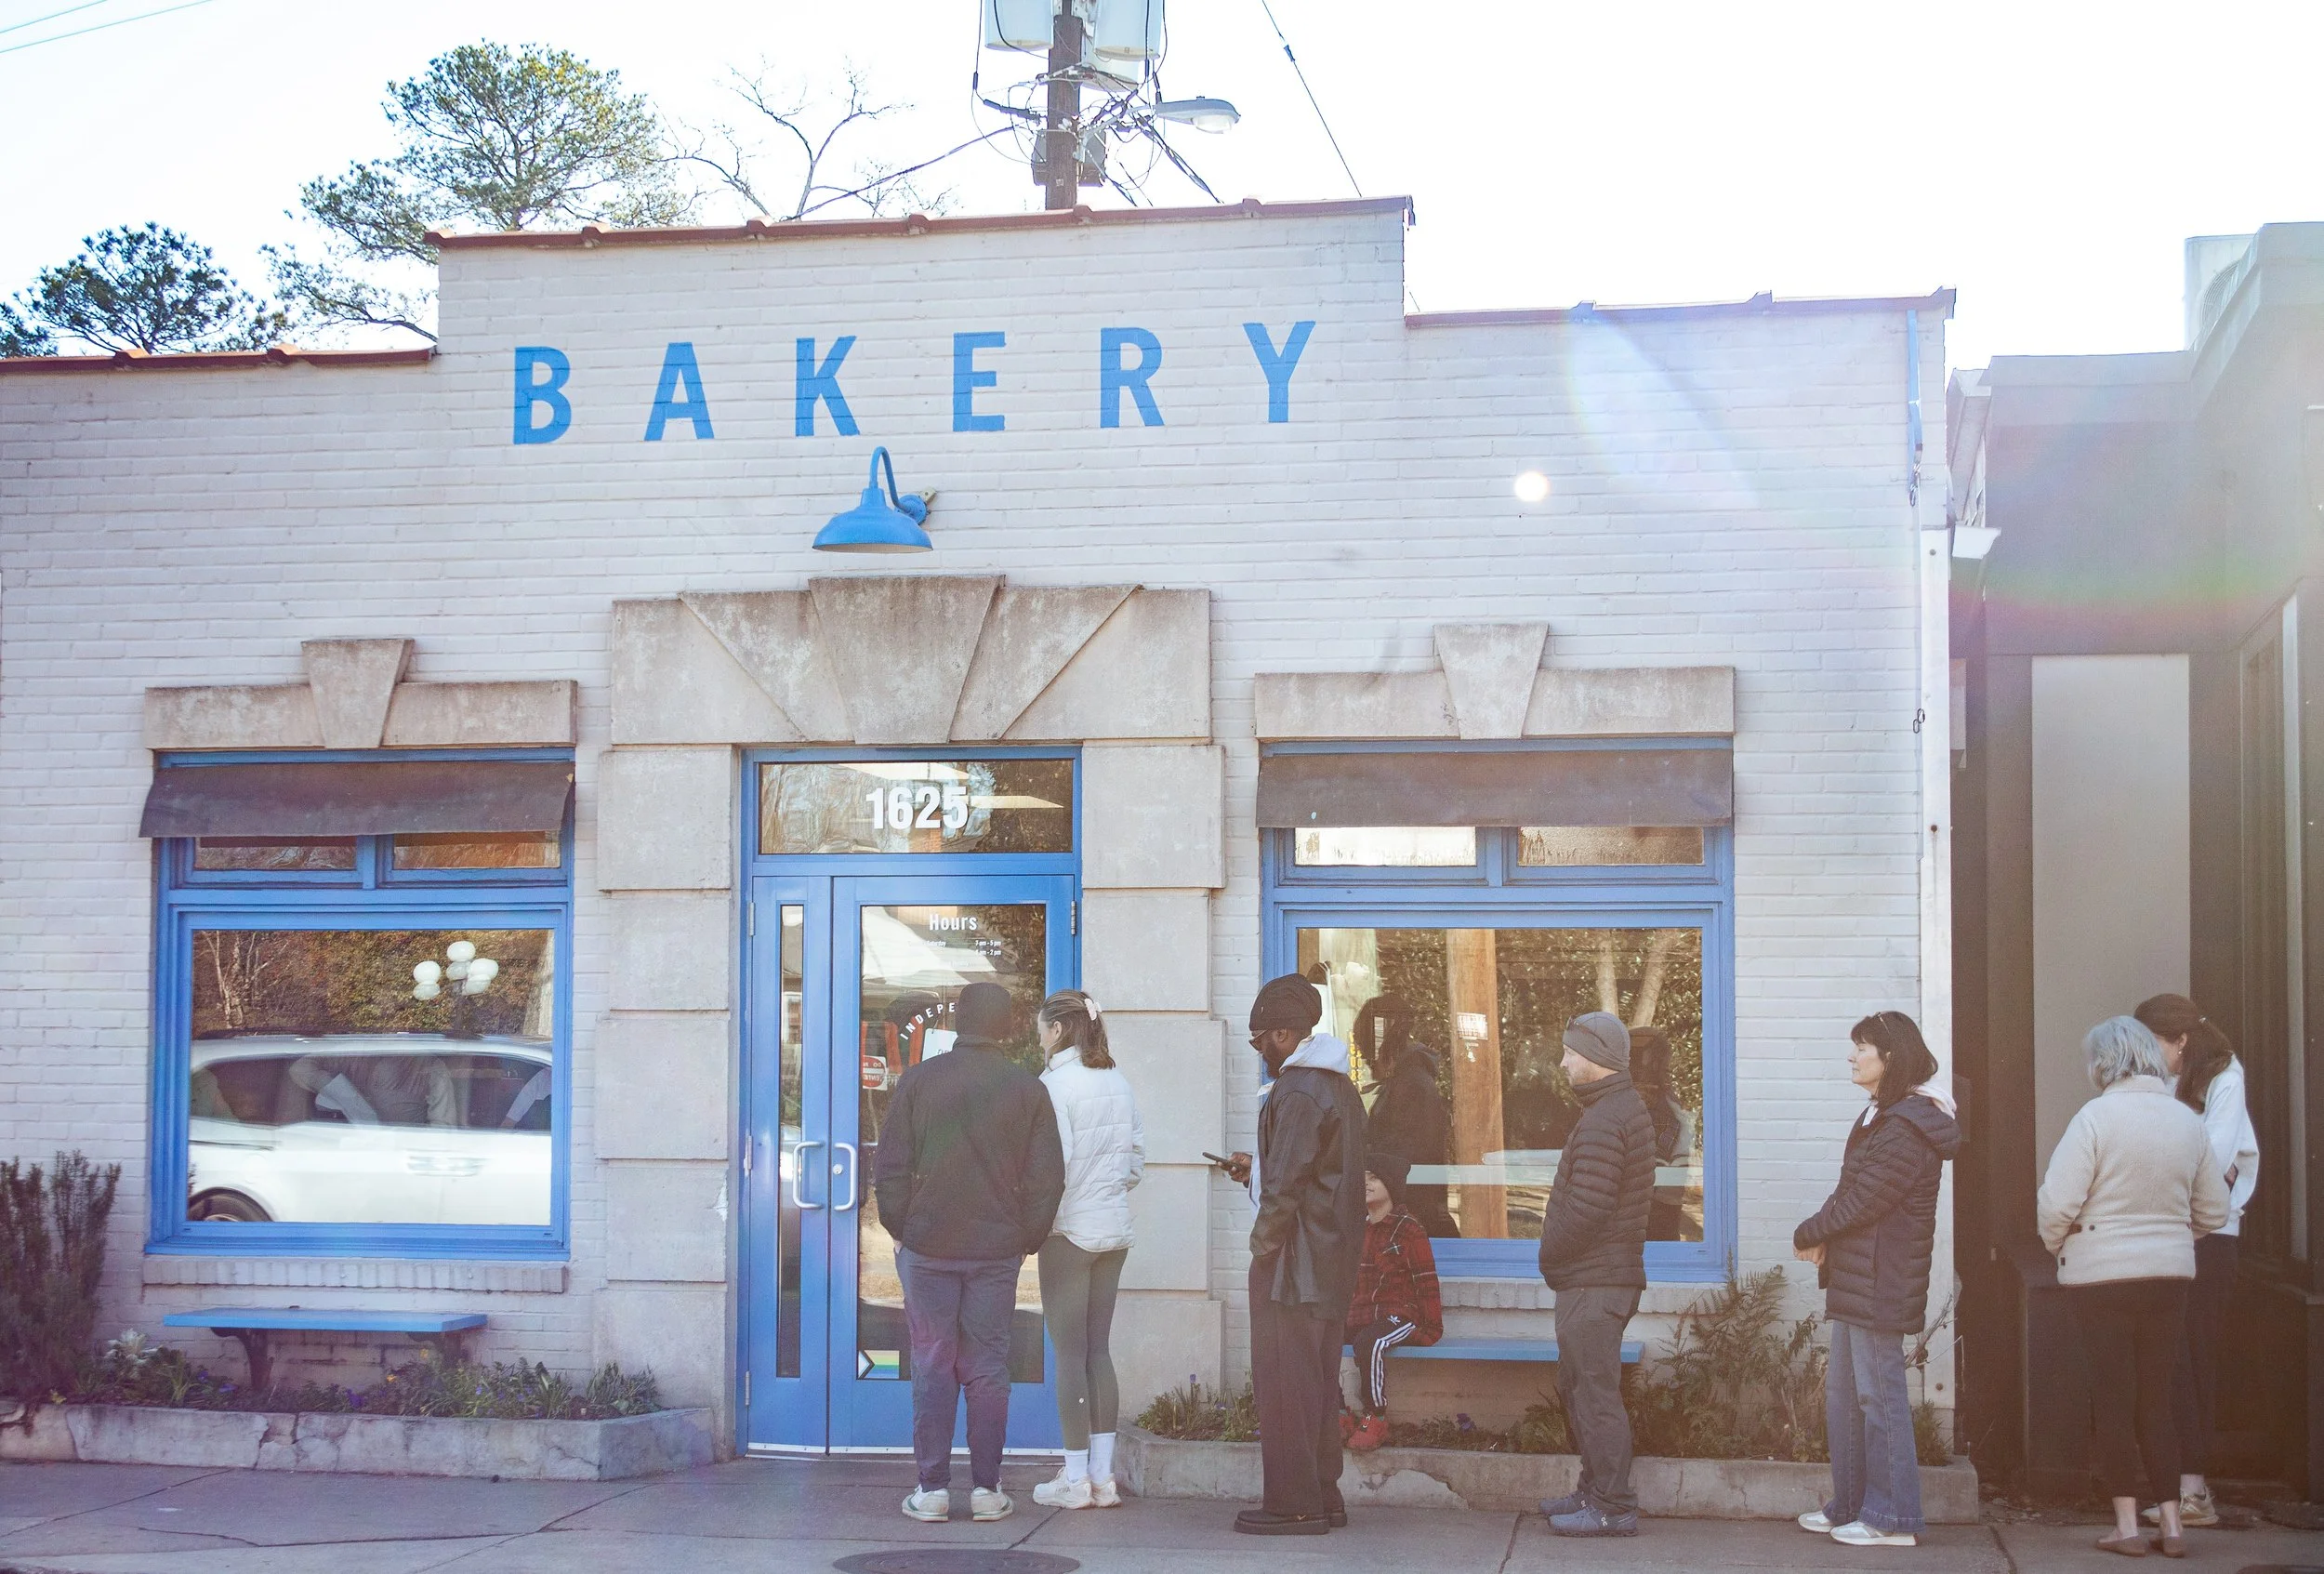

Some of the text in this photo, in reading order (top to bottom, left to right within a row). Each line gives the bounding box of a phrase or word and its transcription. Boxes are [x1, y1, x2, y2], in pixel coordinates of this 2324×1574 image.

[513, 321, 1315, 444] BAKERY
[865, 786, 969, 829] 1625
[929, 914, 977, 931] Hours
[900, 1002, 955, 1040] INDEPE
